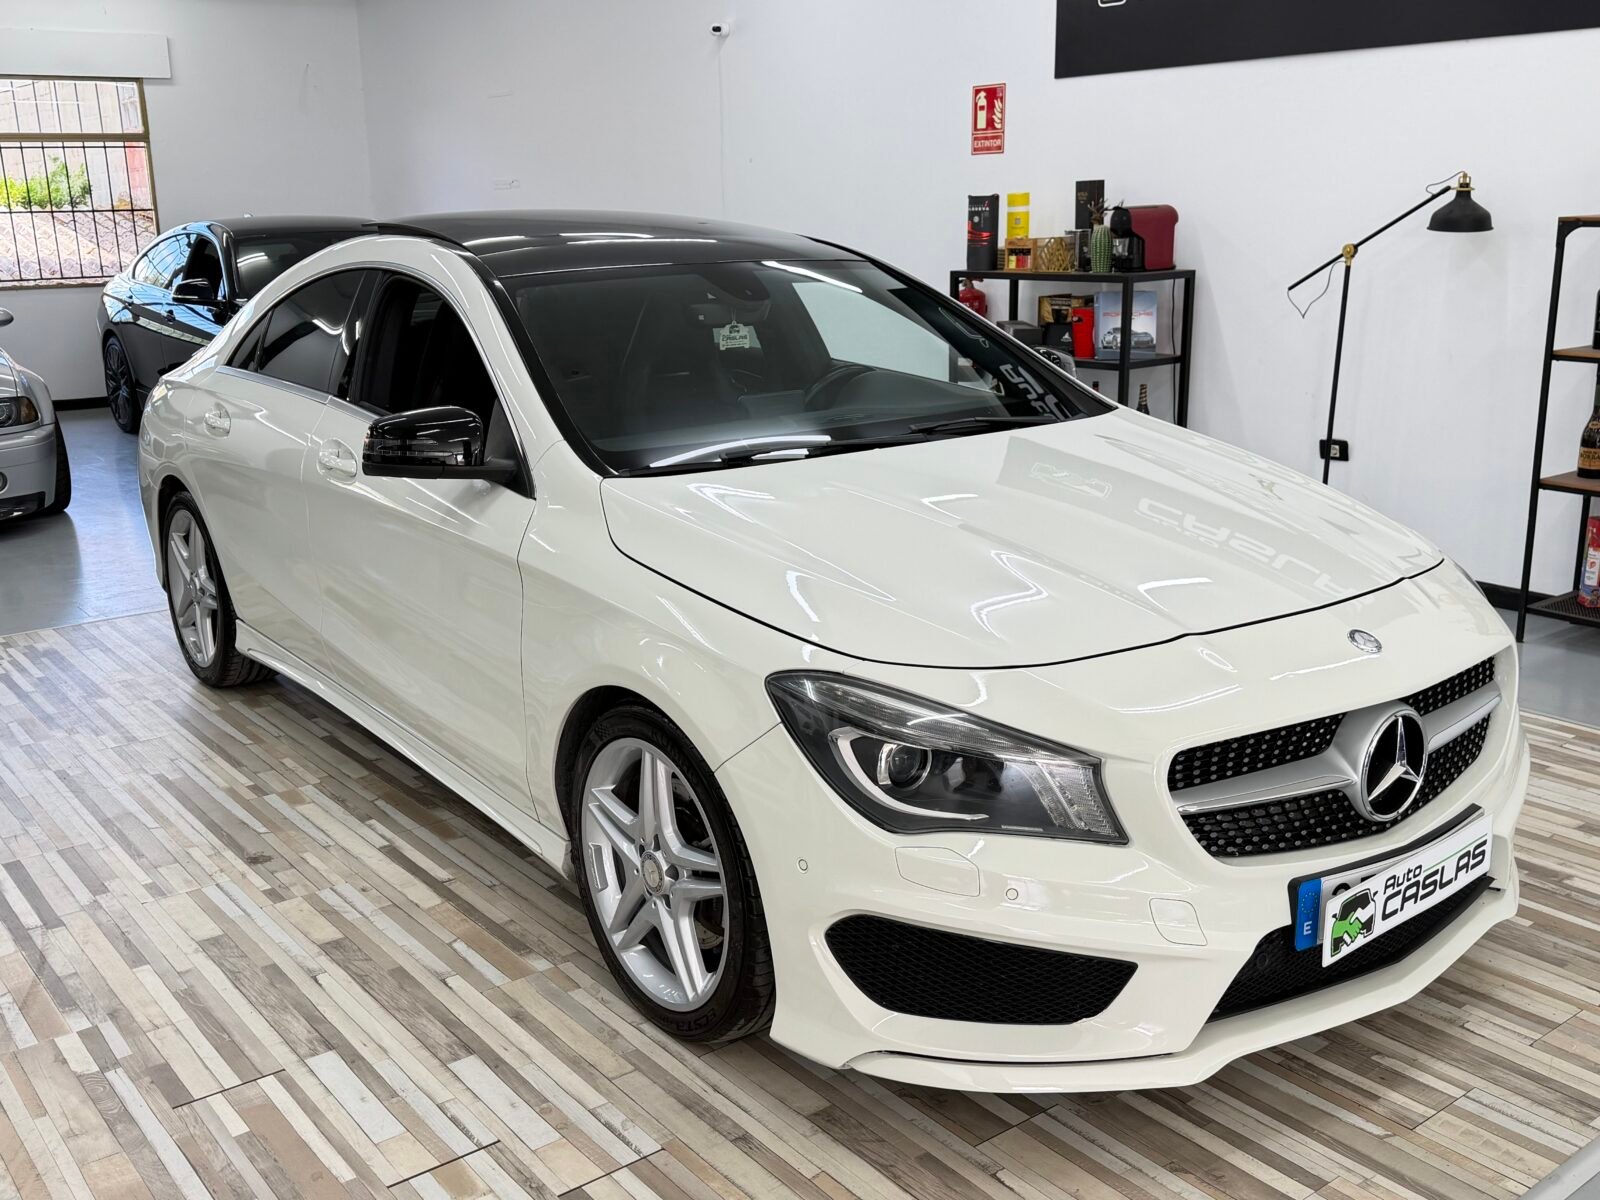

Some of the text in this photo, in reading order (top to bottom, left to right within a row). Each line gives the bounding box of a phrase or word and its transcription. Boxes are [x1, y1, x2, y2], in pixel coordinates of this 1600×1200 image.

[974, 139, 1001, 148] EXTINTOR
[1381, 839, 1488, 921] CASLAS
[1383, 864, 1423, 895] Auto
[1303, 920, 1313, 936] E
